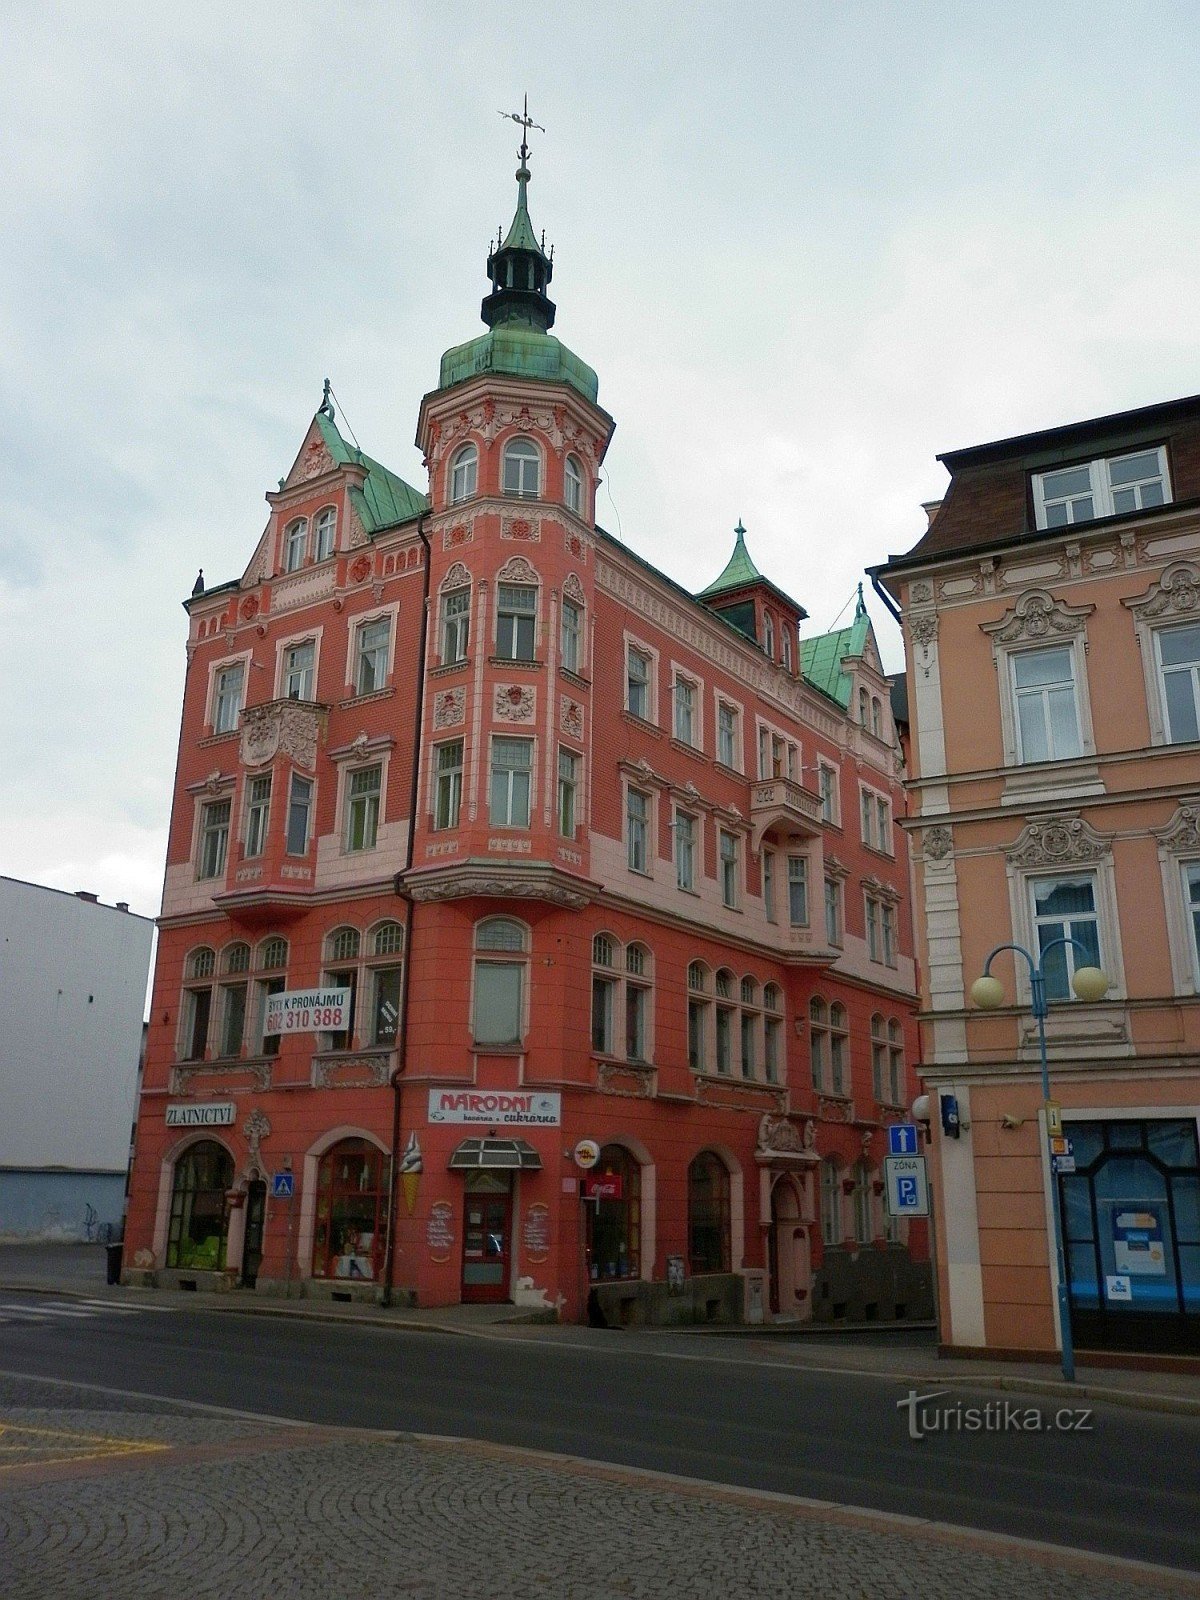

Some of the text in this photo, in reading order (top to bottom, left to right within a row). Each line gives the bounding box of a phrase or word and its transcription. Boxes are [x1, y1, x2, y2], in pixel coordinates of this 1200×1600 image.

[284, 998, 290, 1009] K
[292, 993, 344, 1008] PRONÁJMU
[267, 1008, 342, 1032] 602 310 388
[440, 1093, 535, 1112] NÁRODNÍ
[167, 1103, 231, 1124] ZLATNICTVÍ
[504, 1112, 557, 1123] cukrárna
[893, 1160, 918, 1170] ZÓNA
[901, 1180, 913, 1198] P
